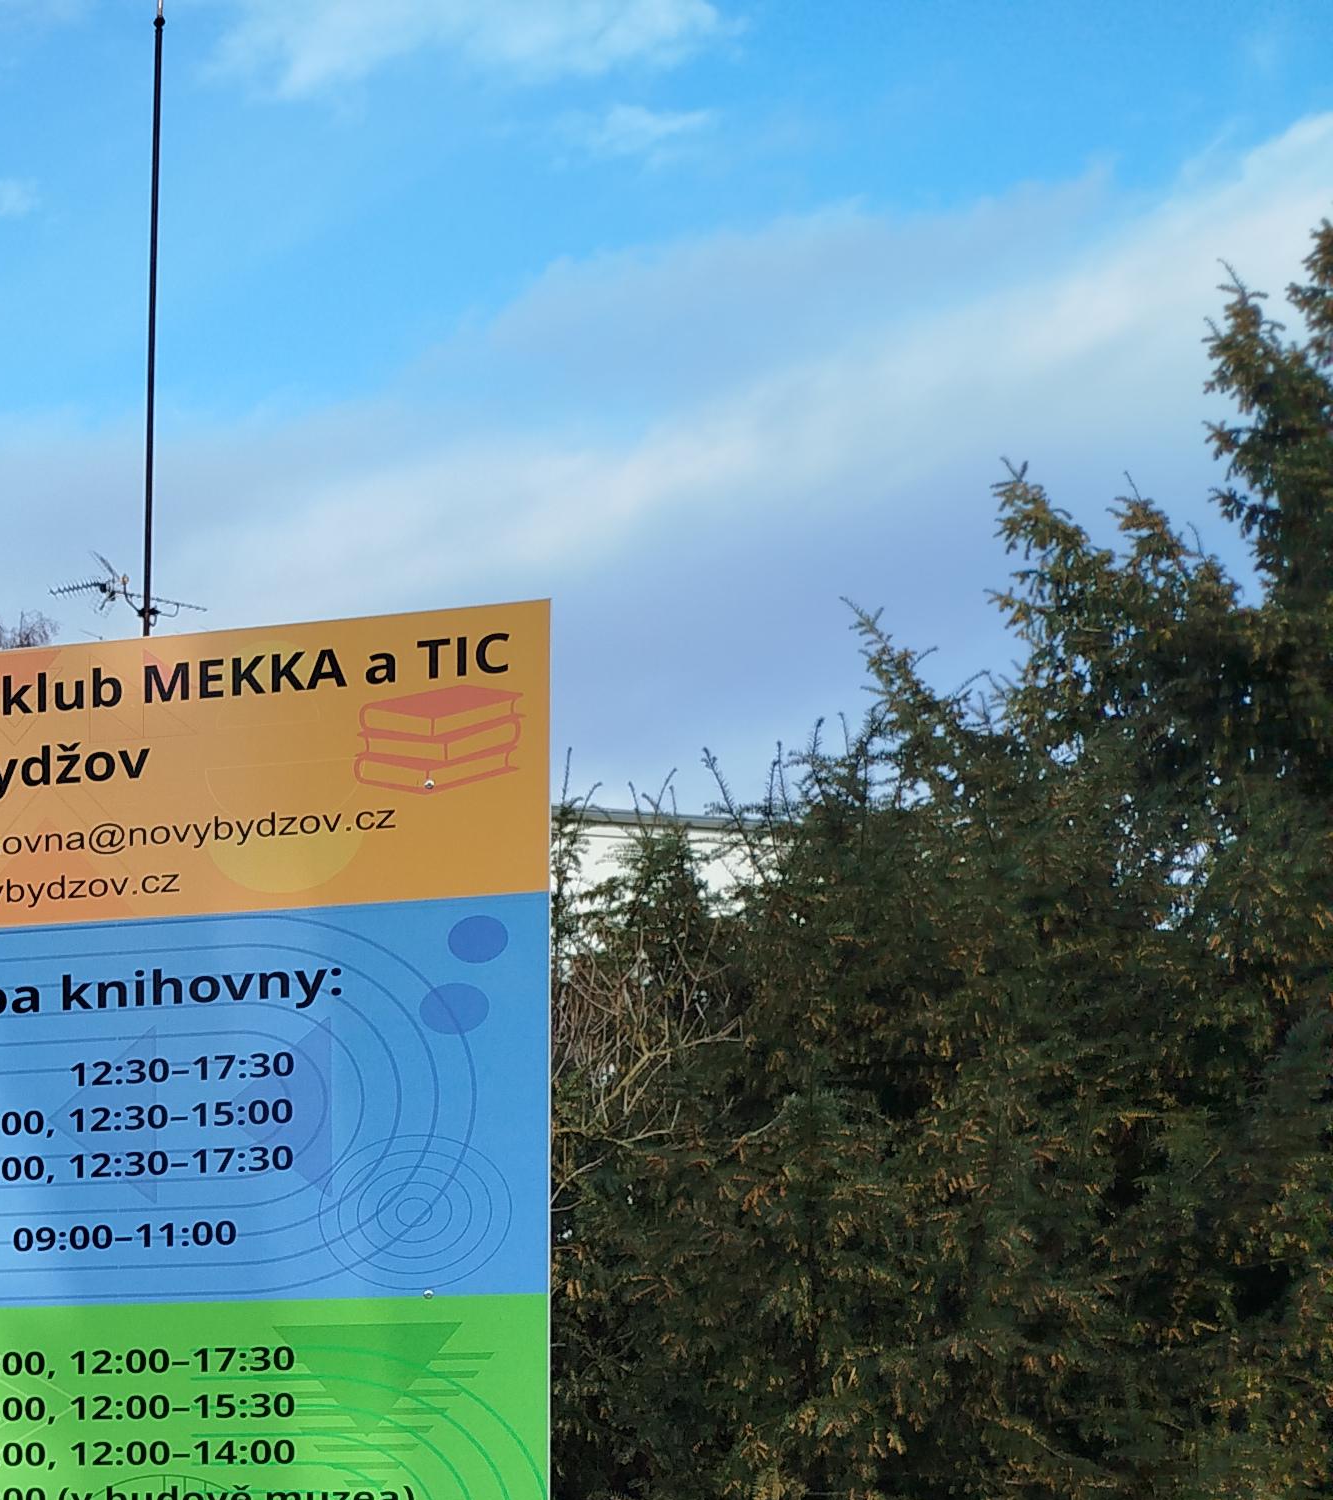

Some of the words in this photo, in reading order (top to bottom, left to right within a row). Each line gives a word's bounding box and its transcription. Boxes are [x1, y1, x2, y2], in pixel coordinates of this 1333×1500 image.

[2, 667, 122, 716] klub
[144, 648, 348, 704] MEKKA
[365, 652, 396, 685] a
[416, 632, 510, 680] TIC
[62, 967, 342, 1011] knihovny:
